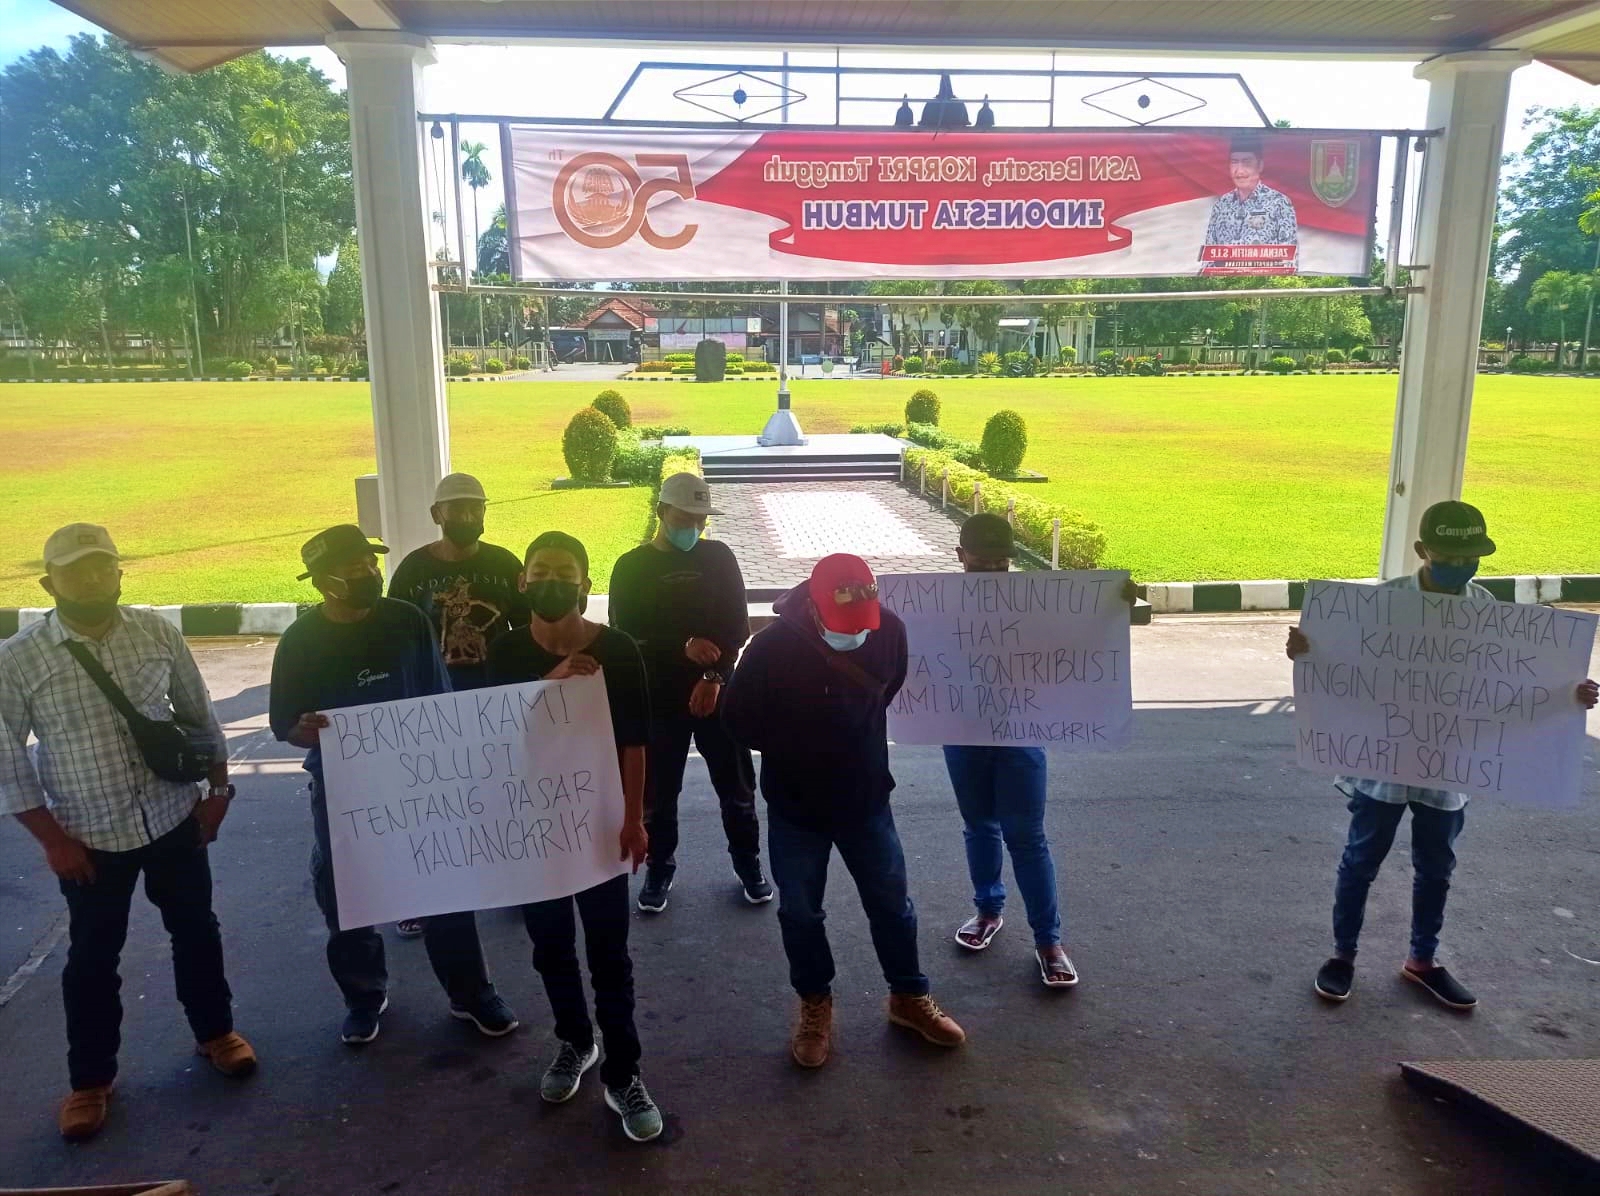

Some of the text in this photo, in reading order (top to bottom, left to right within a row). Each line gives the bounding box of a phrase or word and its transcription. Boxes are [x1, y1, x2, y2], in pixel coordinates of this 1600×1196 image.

[884, 577, 1113, 617] KAMI MENUNTUT
[1306, 585, 1588, 648] KAMI MASYARAKAT
[952, 618, 1023, 650] HAK
[1360, 627, 1537, 678] KALIANGKRIK
[969, 648, 1121, 686] KONTRIBUSI
[1301, 662, 1550, 721] INGIN MENGHADAP
[332, 684, 573, 760] BERIKAN KAMI
[889, 684, 1041, 718] AMI DI PASAR
[1380, 702, 1506, 757] BUPATI
[400, 743, 517, 788] SOLUSI
[1300, 728, 1505, 791] MENCARI SOLUSI
[341, 770, 595, 840] TENTANG PASAR
[409, 808, 593, 875] KALIANGKRIK
